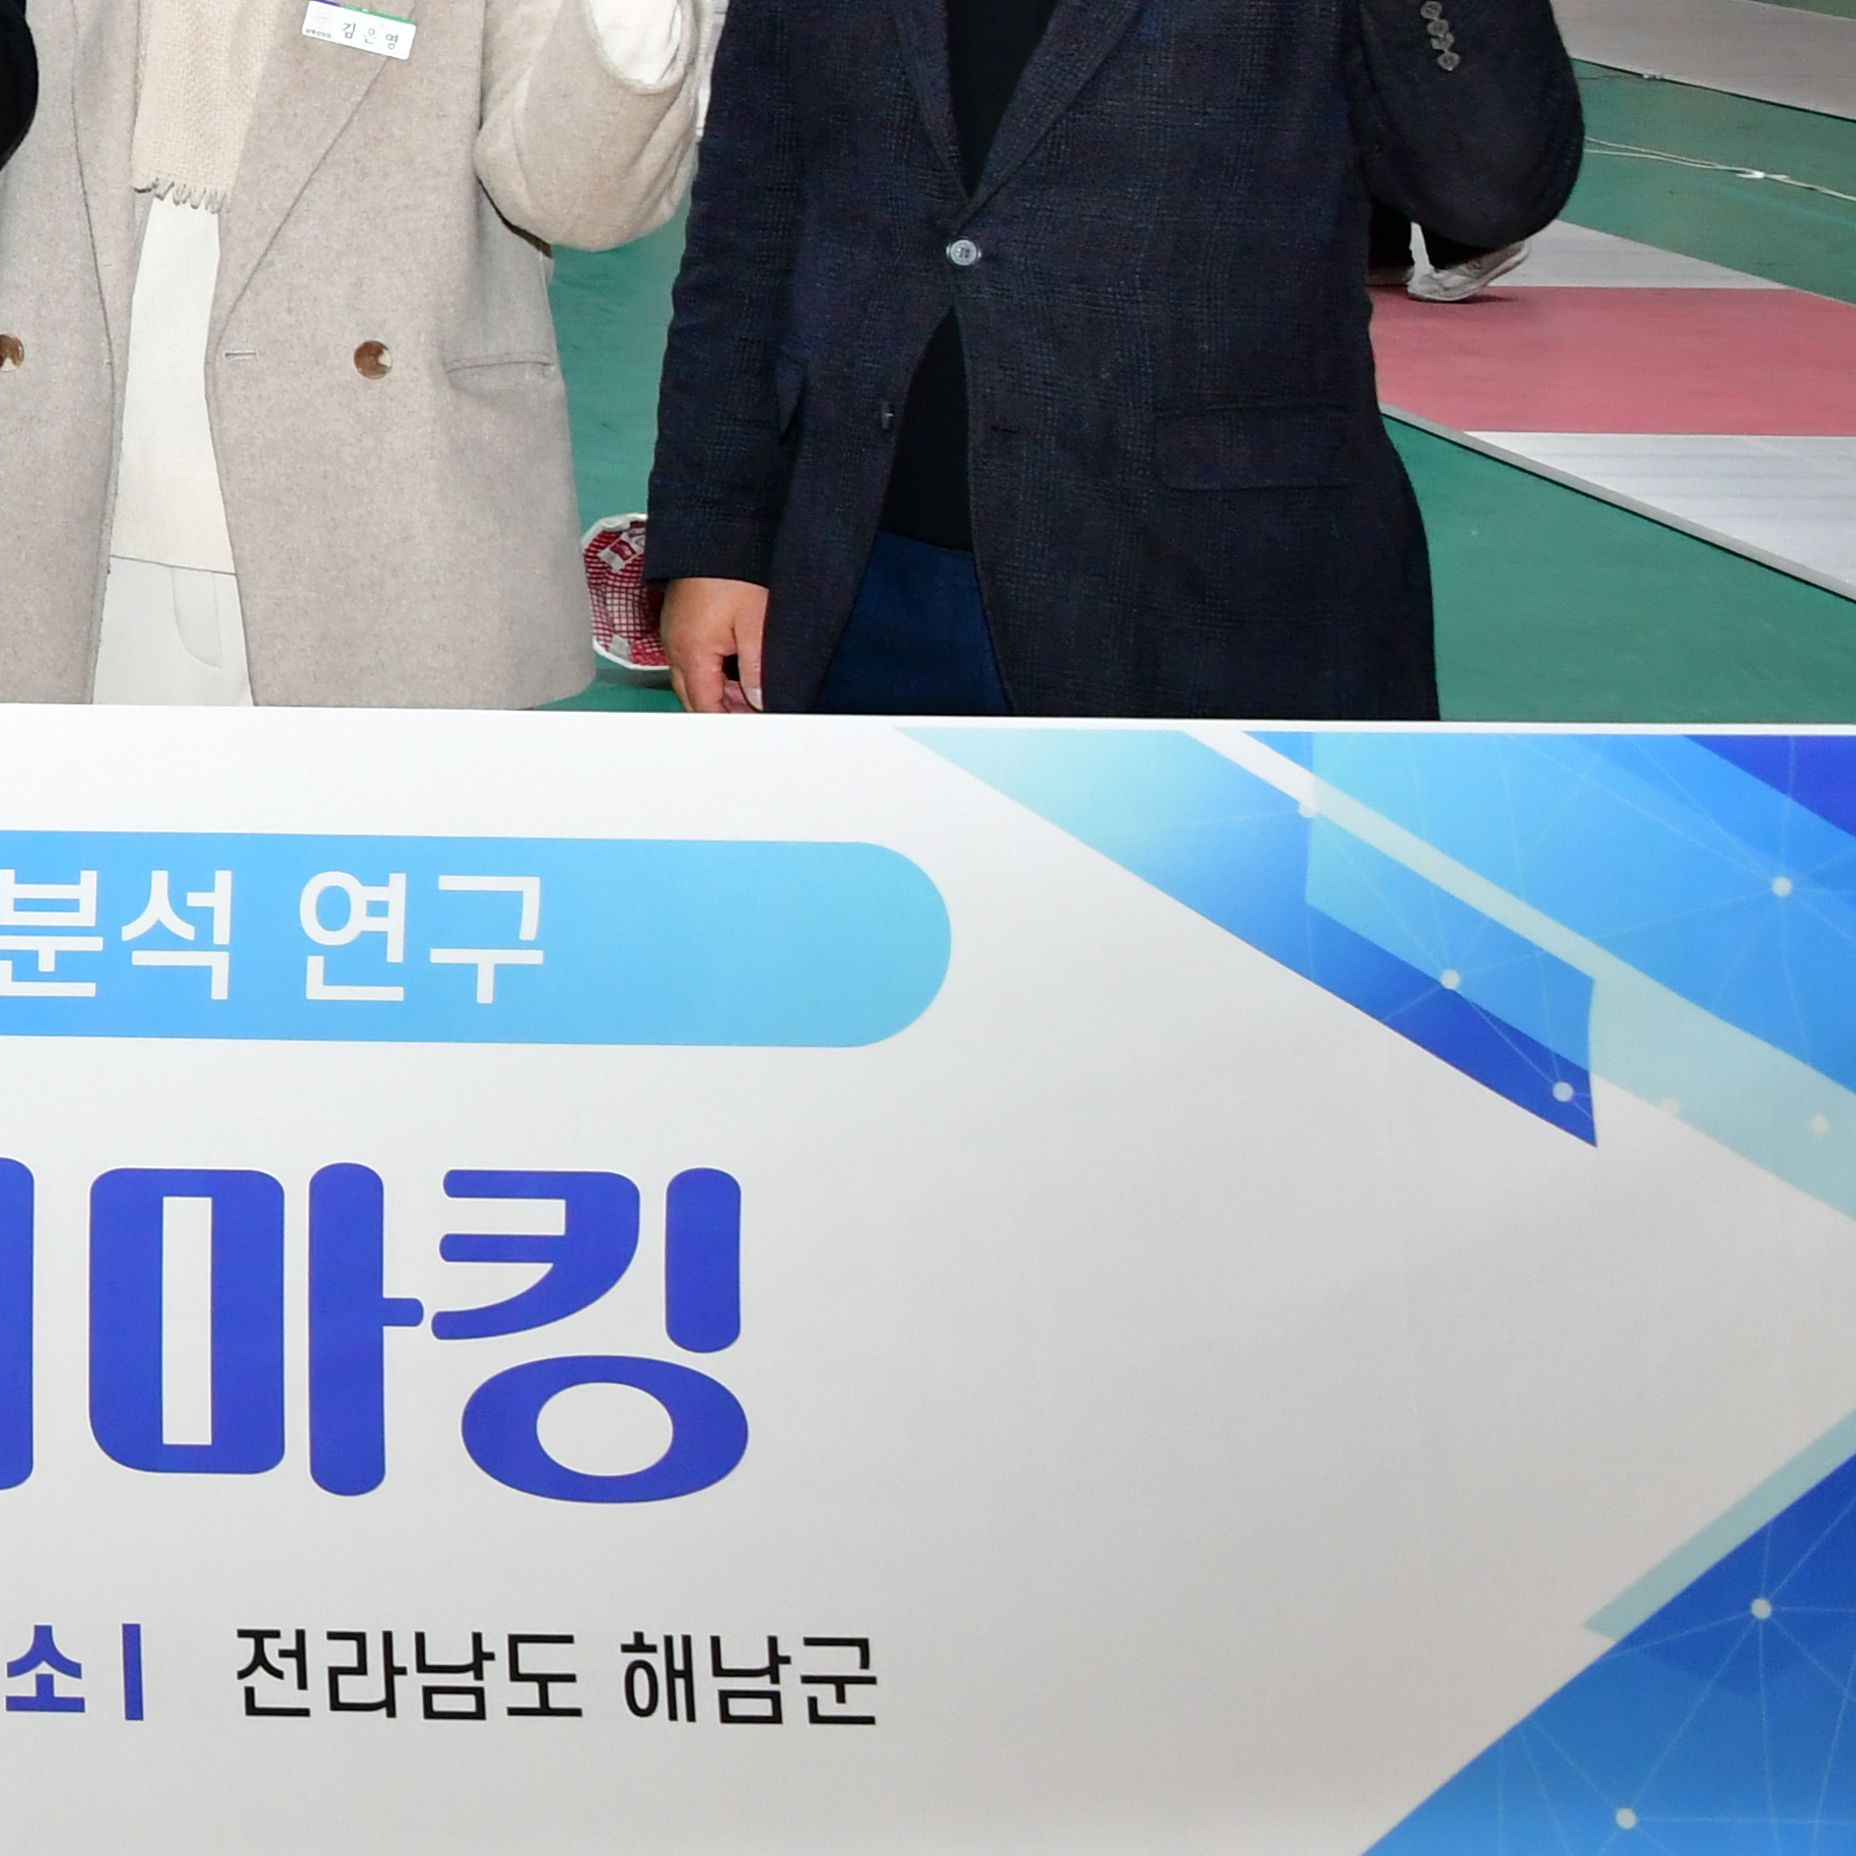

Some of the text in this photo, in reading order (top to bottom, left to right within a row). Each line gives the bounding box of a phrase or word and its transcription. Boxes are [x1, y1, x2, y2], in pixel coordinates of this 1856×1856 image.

[299, 870, 545, 1005] 연구
[236, 1628, 878, 1726] 전라남도 해남군
